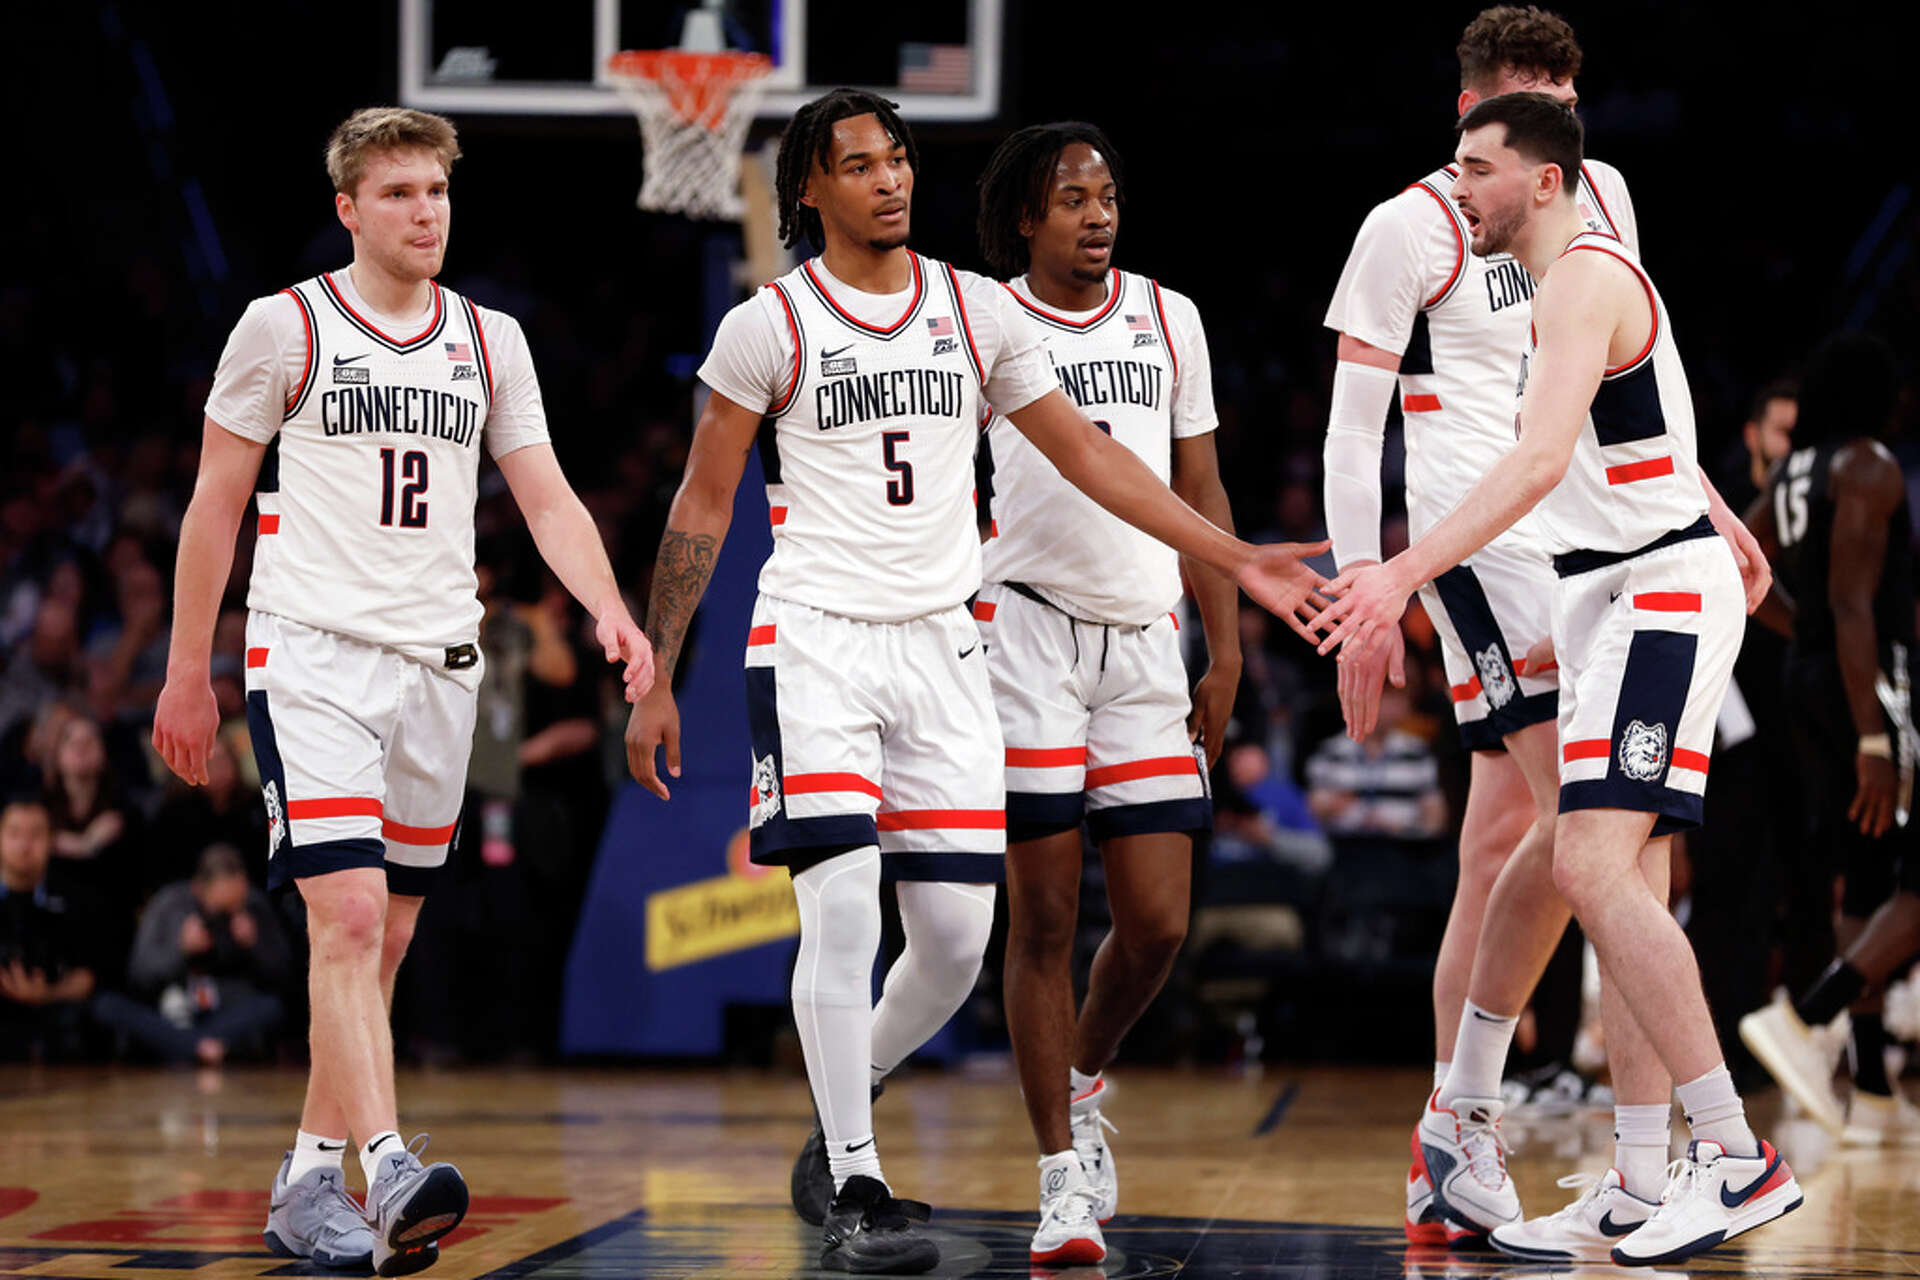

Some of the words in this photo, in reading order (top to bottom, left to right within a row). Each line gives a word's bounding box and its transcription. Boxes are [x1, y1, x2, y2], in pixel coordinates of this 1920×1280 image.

[322, 386, 479, 448] CONNECTICUT
[815, 369, 964, 431] CONNECTICUT
[380, 448, 428, 529] 12
[882, 431, 915, 506] 5
[1774, 476, 1811, 547] 15
